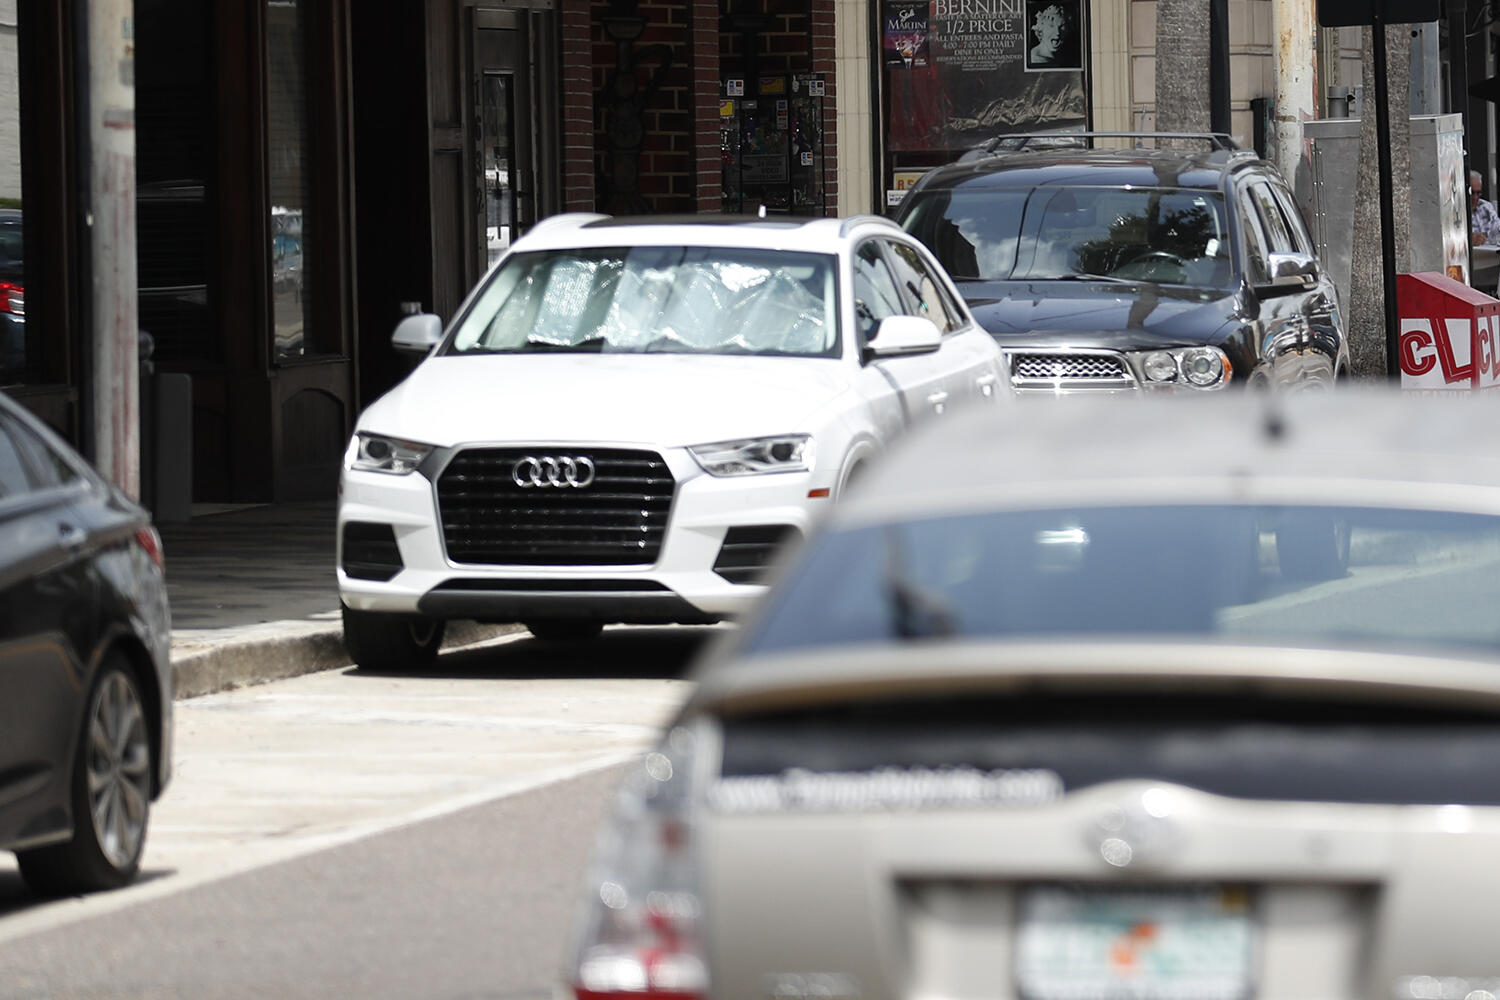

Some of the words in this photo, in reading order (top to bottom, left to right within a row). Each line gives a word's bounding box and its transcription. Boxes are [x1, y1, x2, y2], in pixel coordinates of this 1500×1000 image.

[946, 20, 965, 34] 1/2
[969, 19, 1013, 33] PRICE
[992, 40, 1016, 48] DAILY
